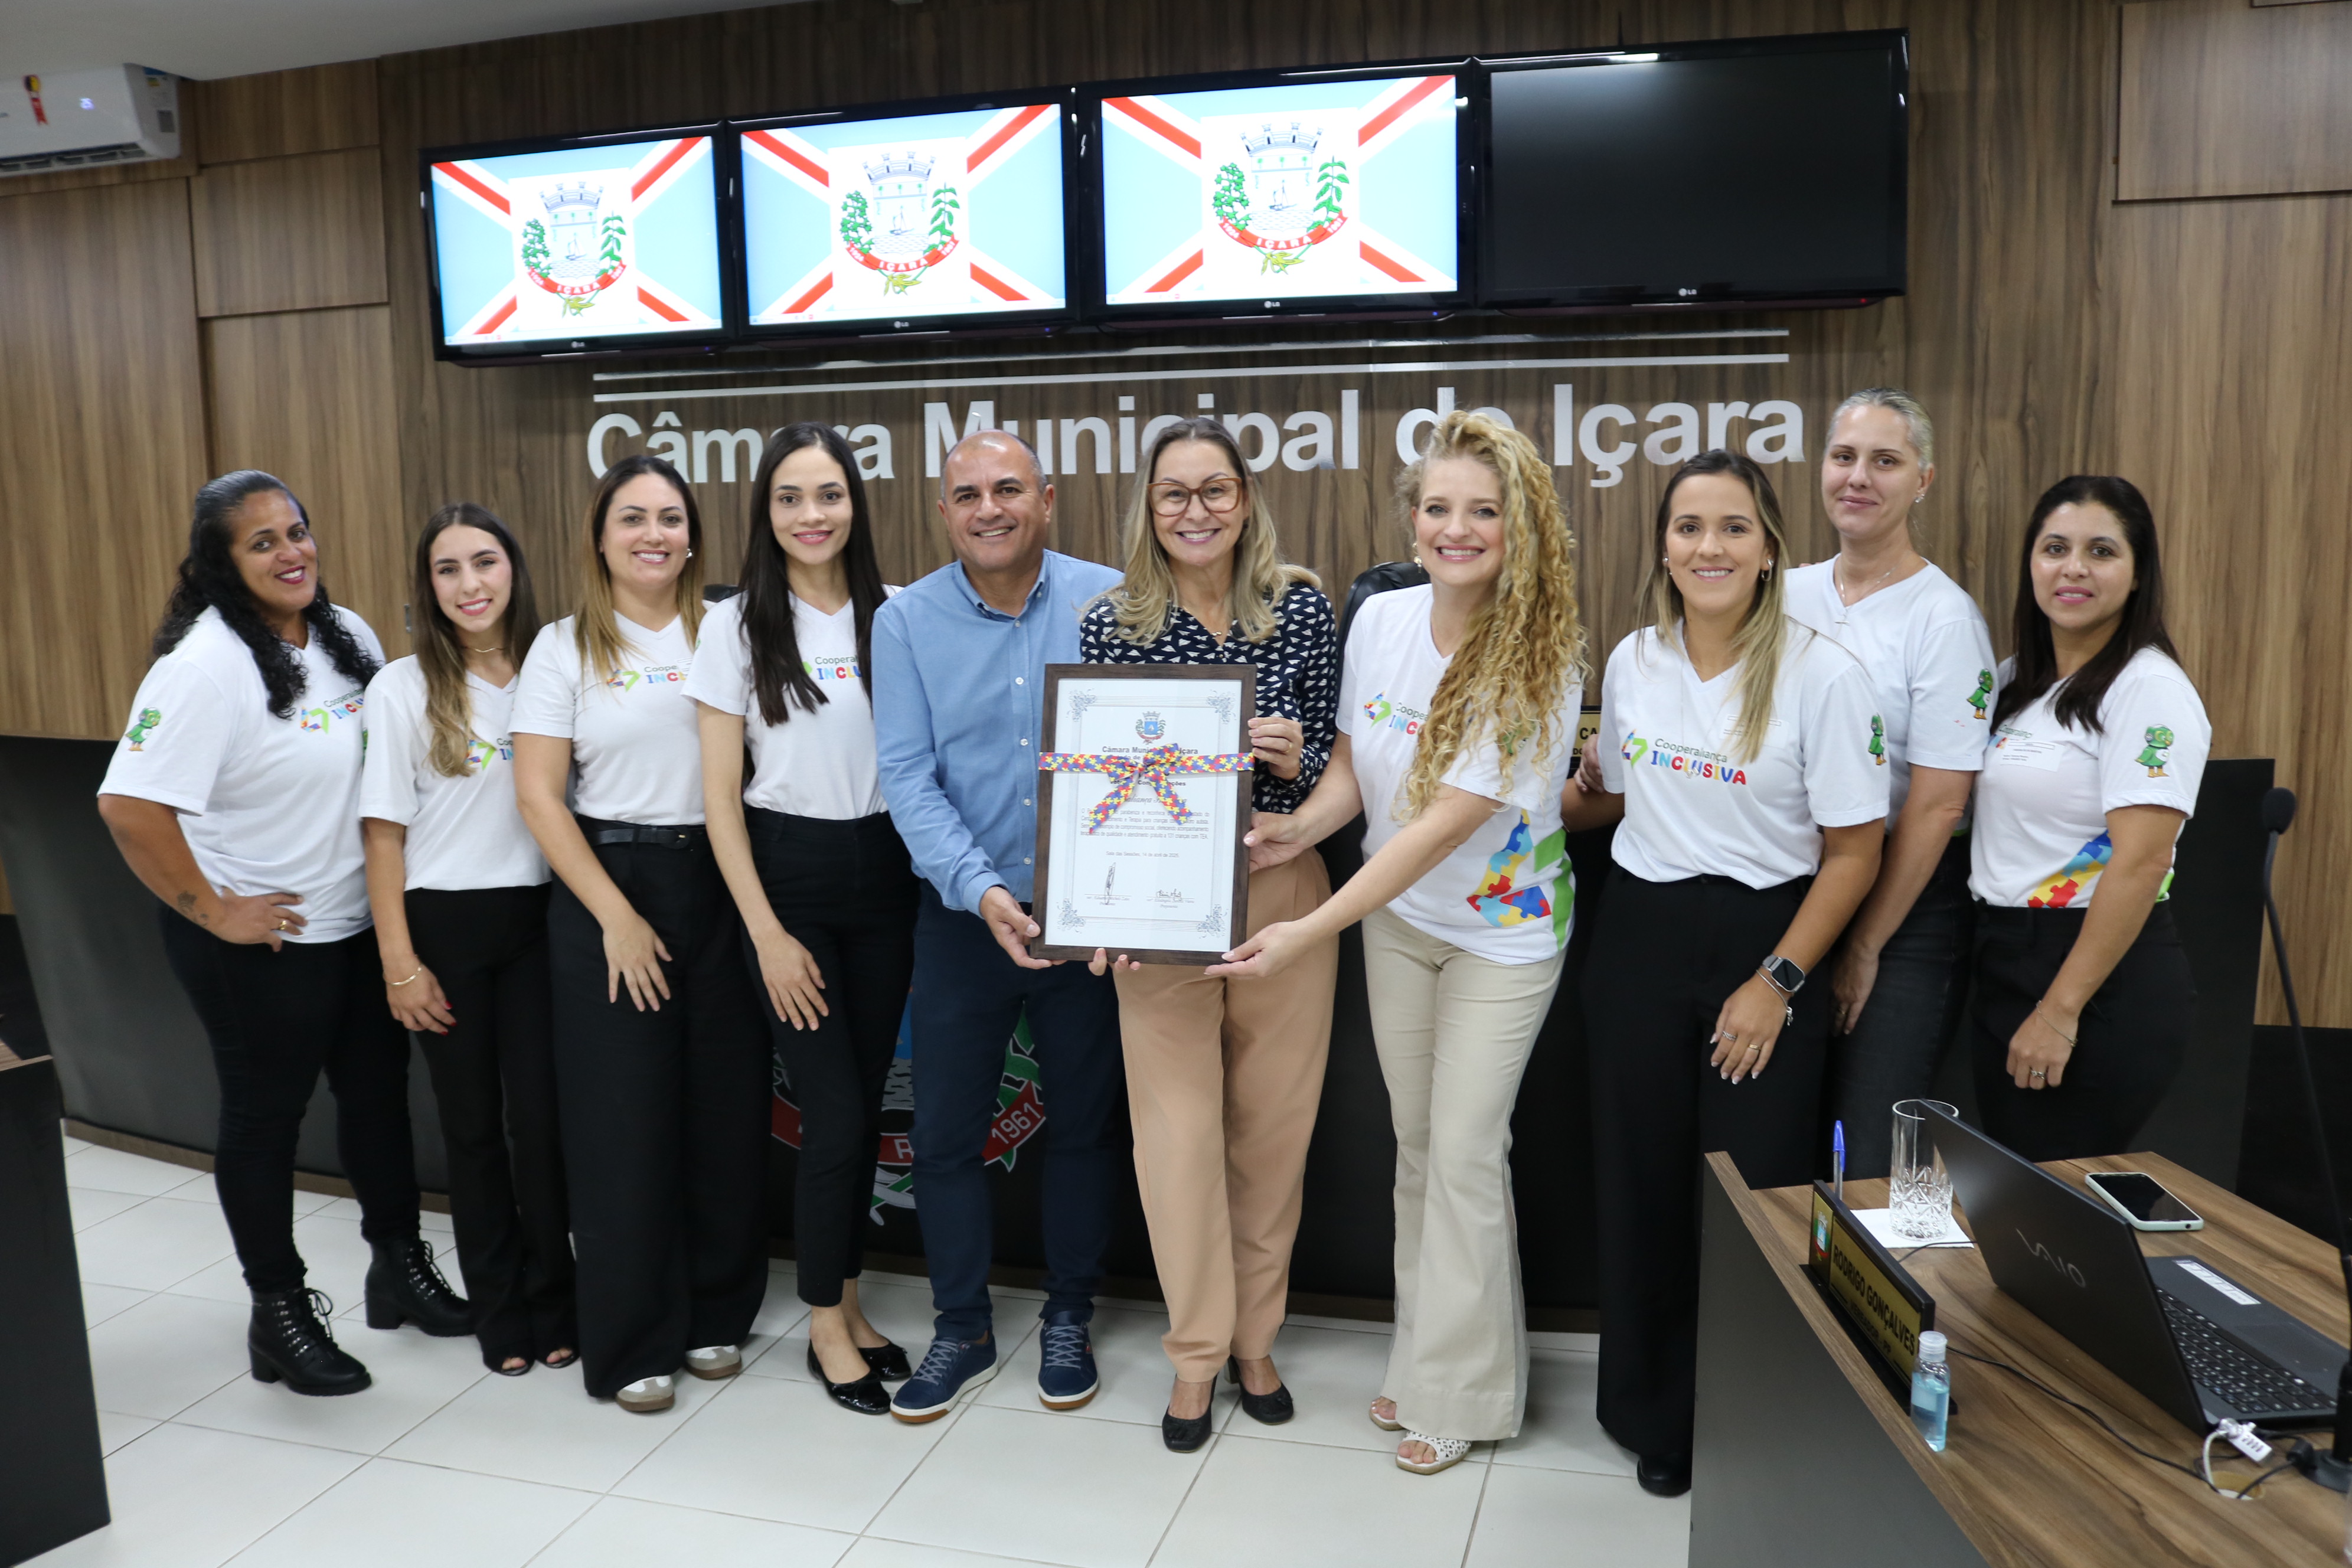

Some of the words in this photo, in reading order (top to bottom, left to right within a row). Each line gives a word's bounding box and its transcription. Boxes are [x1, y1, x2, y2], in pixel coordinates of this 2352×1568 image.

[1554, 384, 1806, 488] Içara
[1651, 750, 1746, 785] INCLUSIVA
[1655, 738, 1727, 764] Cooperaliança
[991, 1102, 1041, 1144] 1961
[2015, 1227, 2086, 1288] VAIO
[1834, 1244, 1865, 1297] RODRIGO
[1867, 1284, 1915, 1356] GONÇALVES
